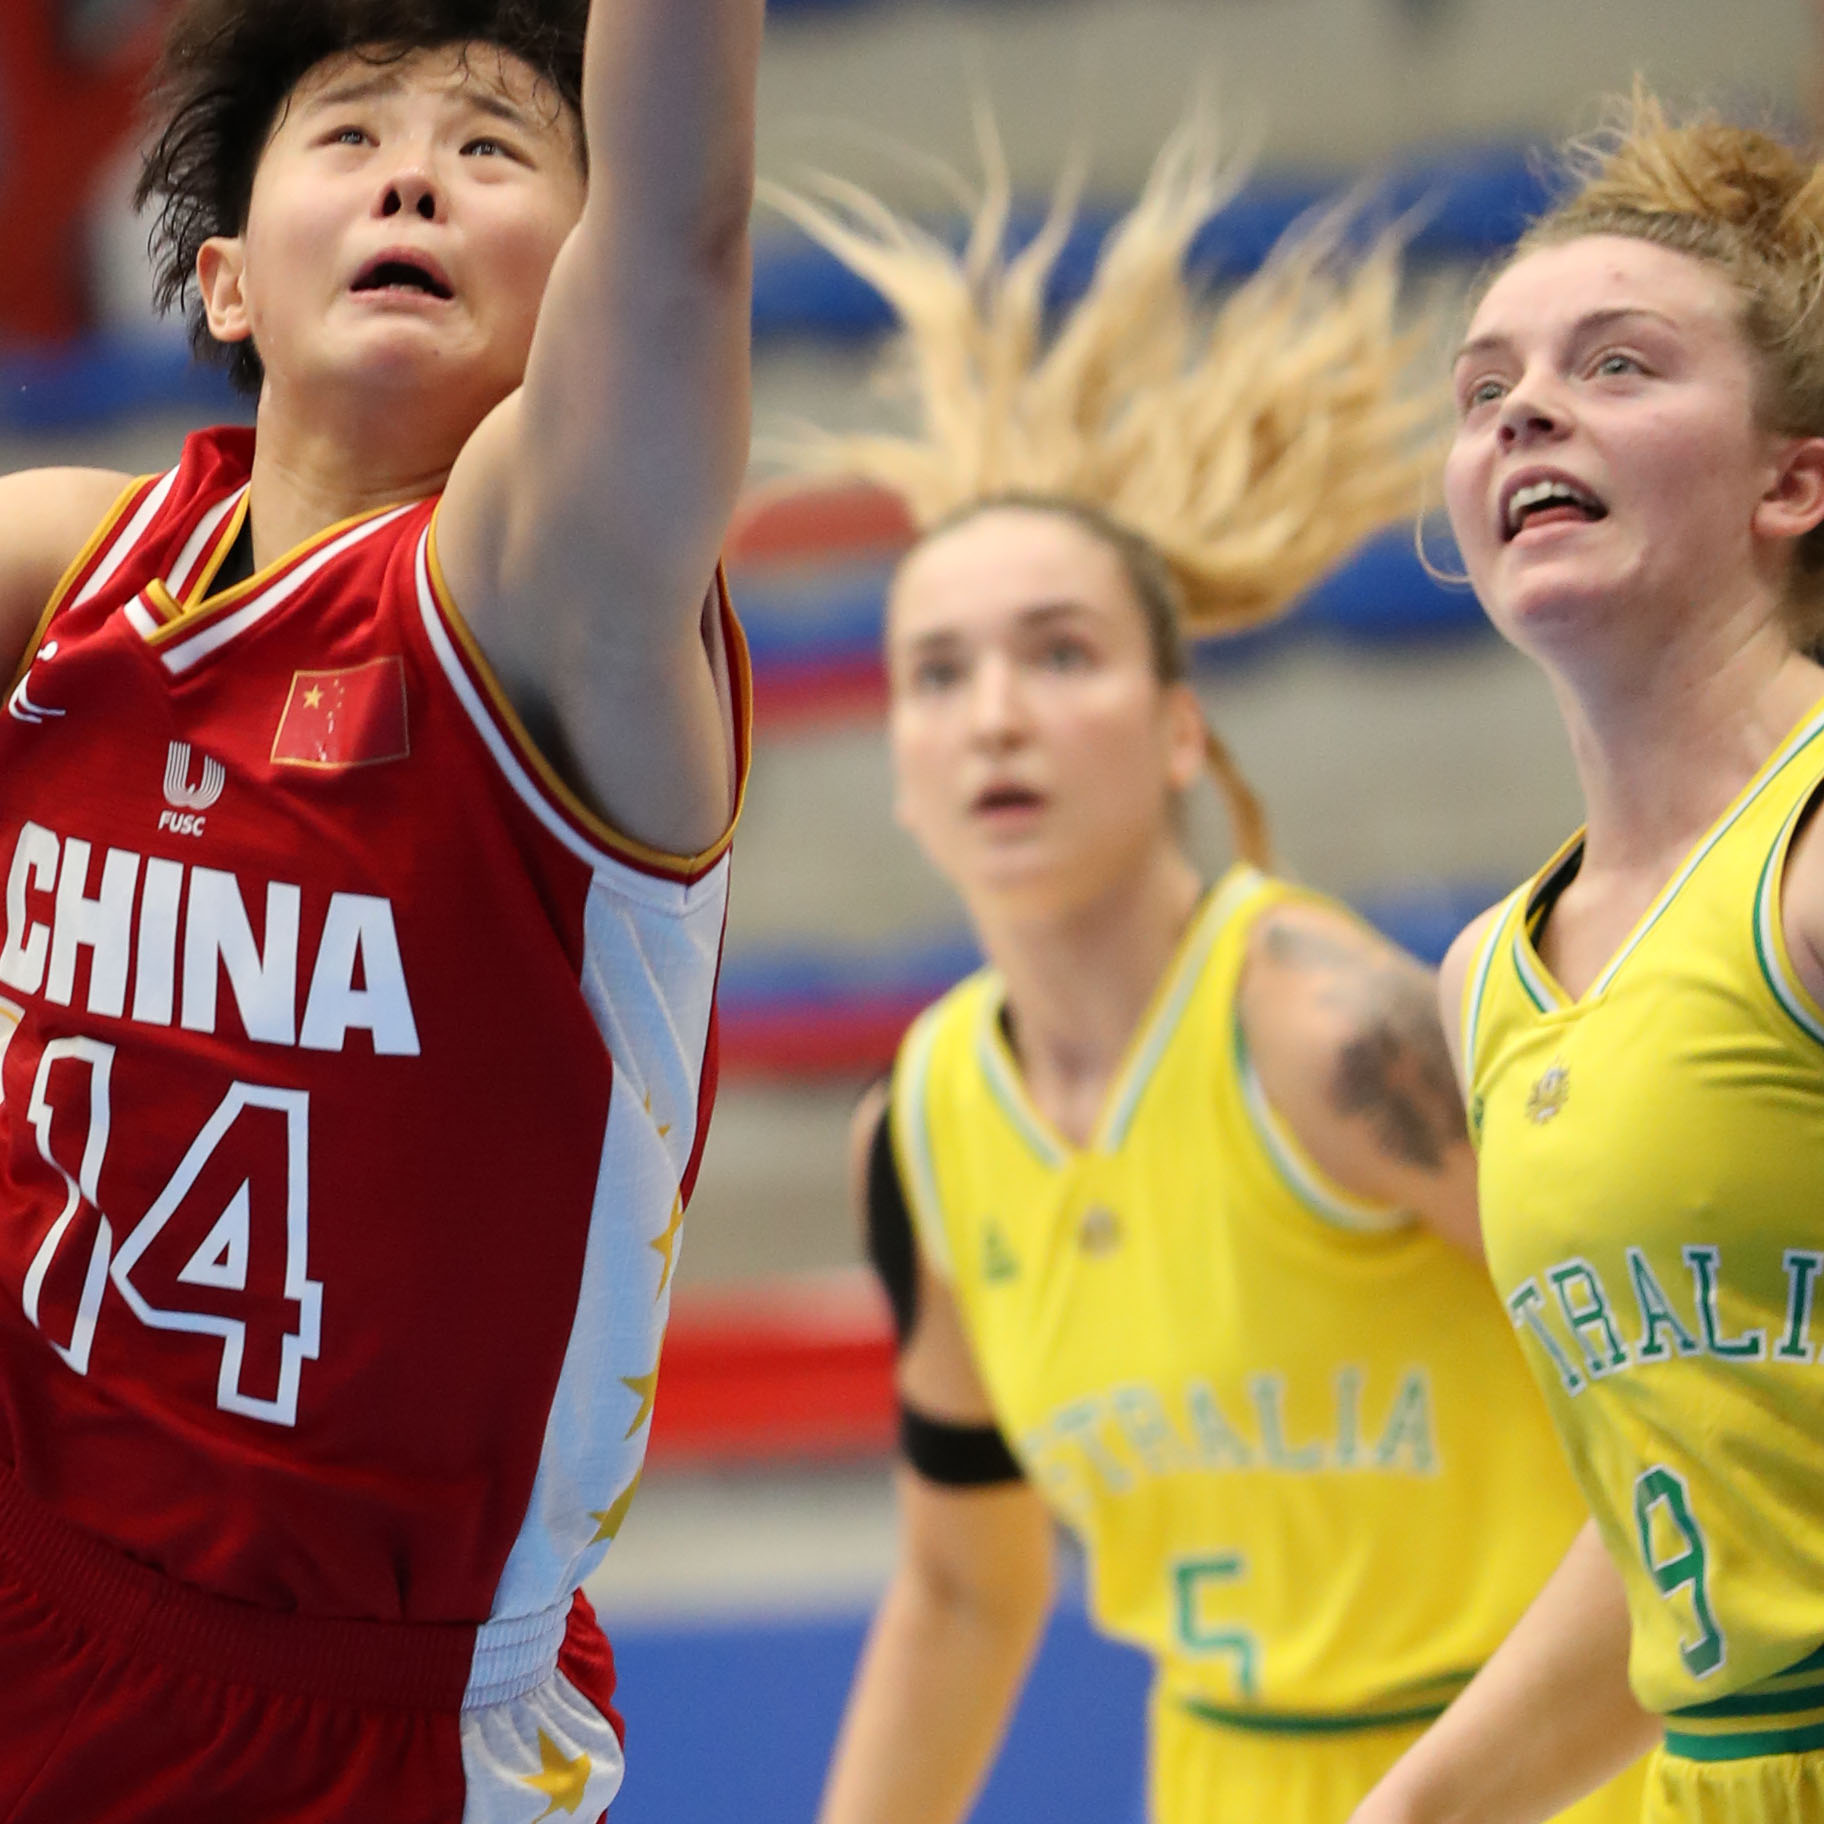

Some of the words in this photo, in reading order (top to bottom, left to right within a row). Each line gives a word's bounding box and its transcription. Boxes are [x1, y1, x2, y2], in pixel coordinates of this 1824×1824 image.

[157, 808, 207, 838] FUSC
[22, 1035, 324, 1428] 14
[1507, 1244, 1824, 1398] TRALI
[1171, 1550, 1264, 1704] 5
[1631, 1464, 1727, 1682] 9
